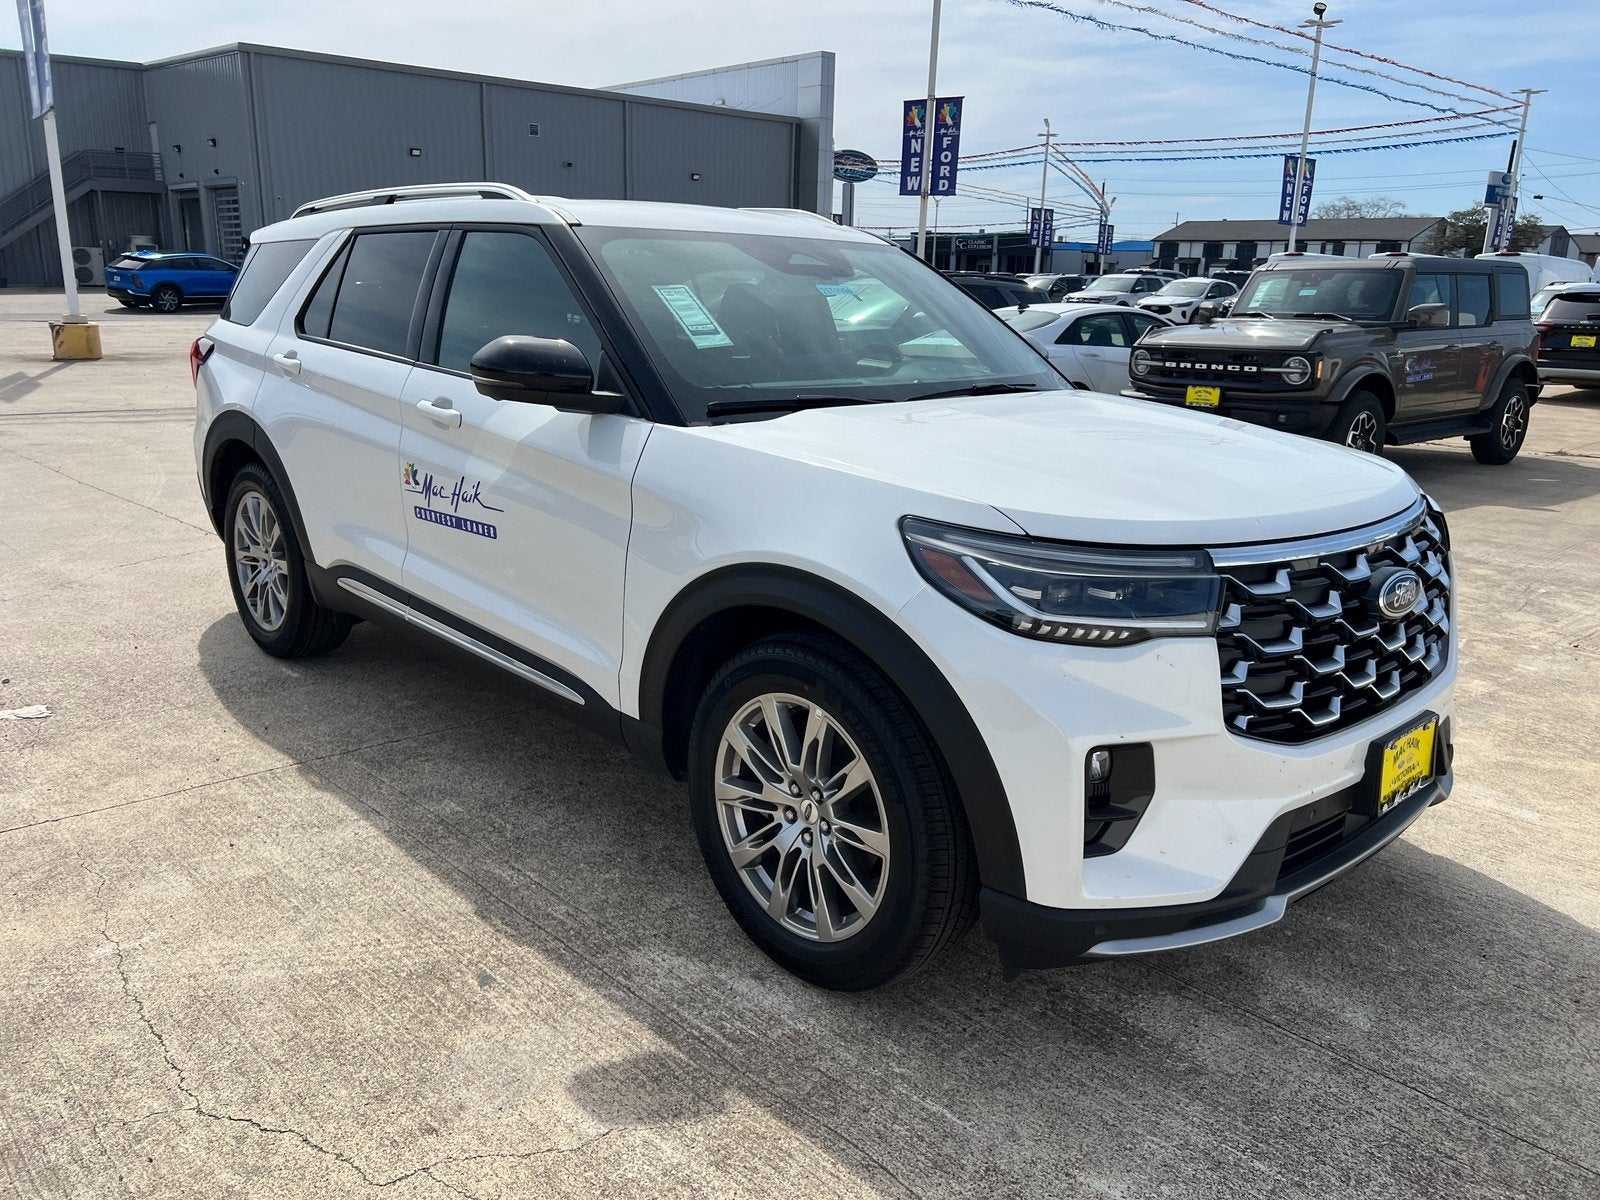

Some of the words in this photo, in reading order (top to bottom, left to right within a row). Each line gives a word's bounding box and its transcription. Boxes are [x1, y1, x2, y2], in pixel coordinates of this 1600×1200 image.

[907, 139, 921, 191] NEW
[938, 137, 952, 191] FORD
[1283, 183, 1293, 221] NEW
[1298, 186, 1309, 224] FORD
[1031, 224, 1039, 246] NEW
[1165, 361, 1257, 372] BRONCO
[404, 473, 450, 508] Mac
[451, 476, 504, 513] Haik
[416, 507, 457, 527] COURTESY
[461, 518, 495, 538] LOANER
[1393, 580, 1417, 608] Ford
[1393, 741, 1406, 767] MAC
